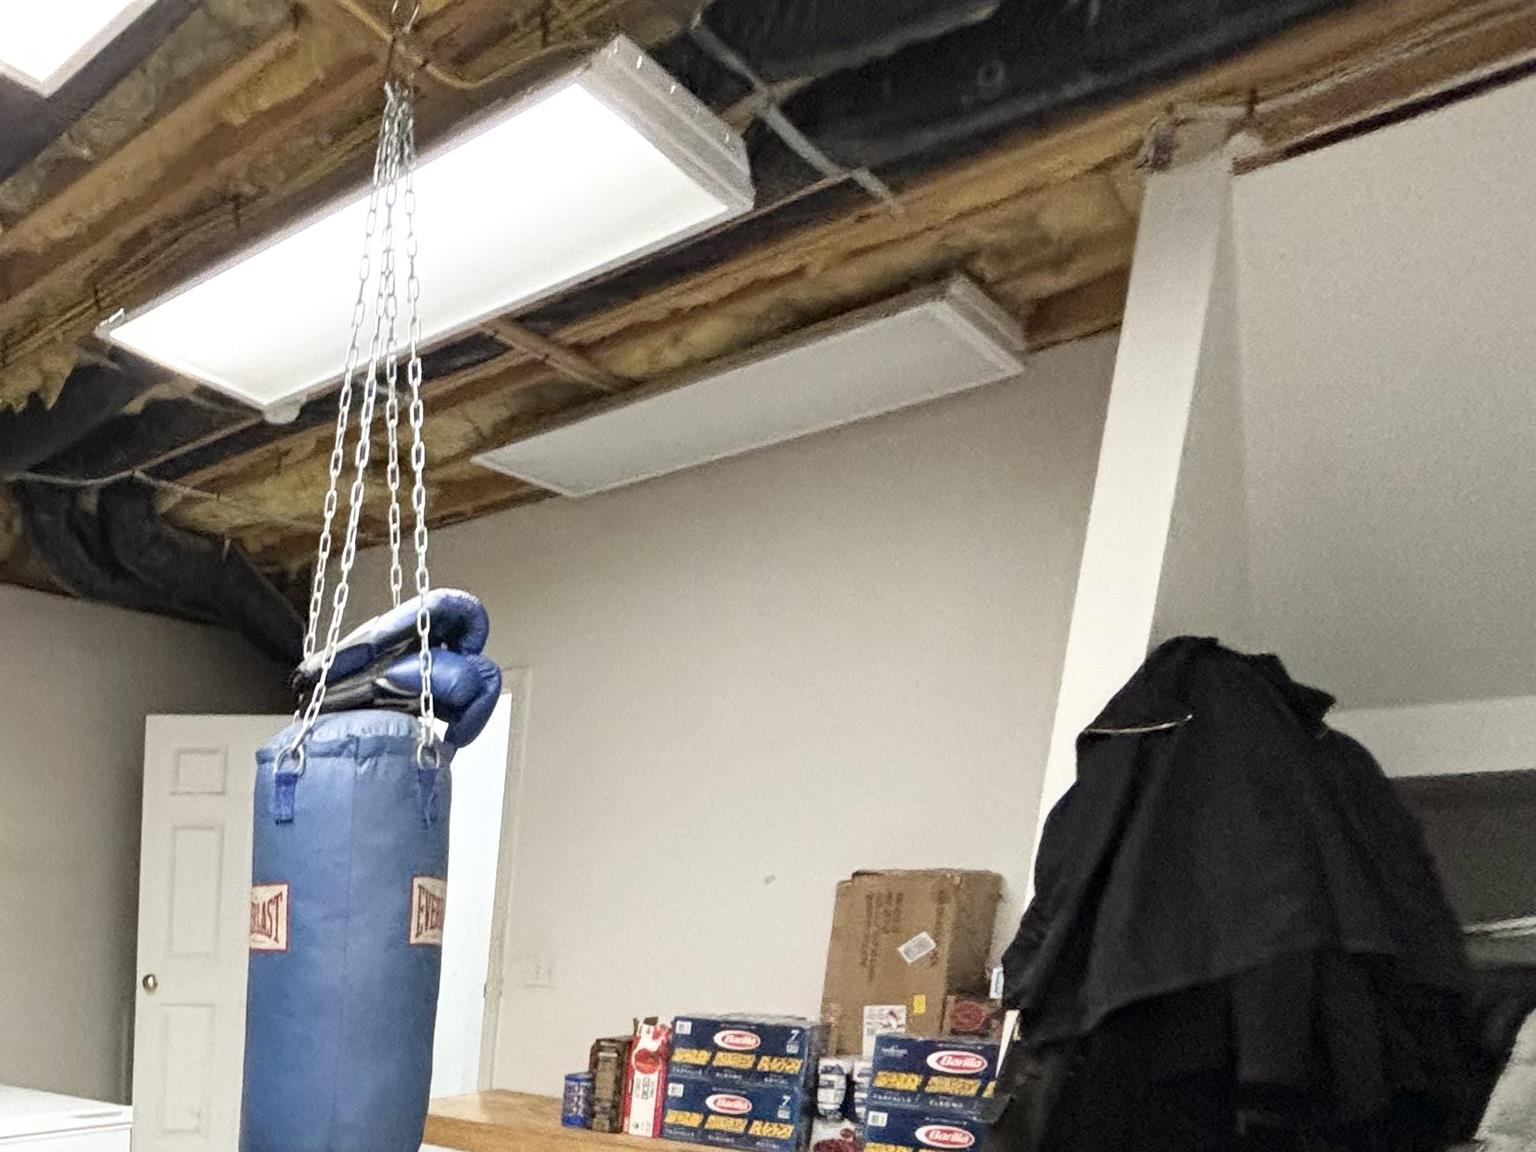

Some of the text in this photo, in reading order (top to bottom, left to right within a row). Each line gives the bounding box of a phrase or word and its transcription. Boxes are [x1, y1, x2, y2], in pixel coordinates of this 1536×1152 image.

[790, 1029, 800, 1041] 7
[939, 1054, 984, 1068] Barilla
[781, 1094, 792, 1107] 7
[927, 1129, 971, 1143] Barilla
